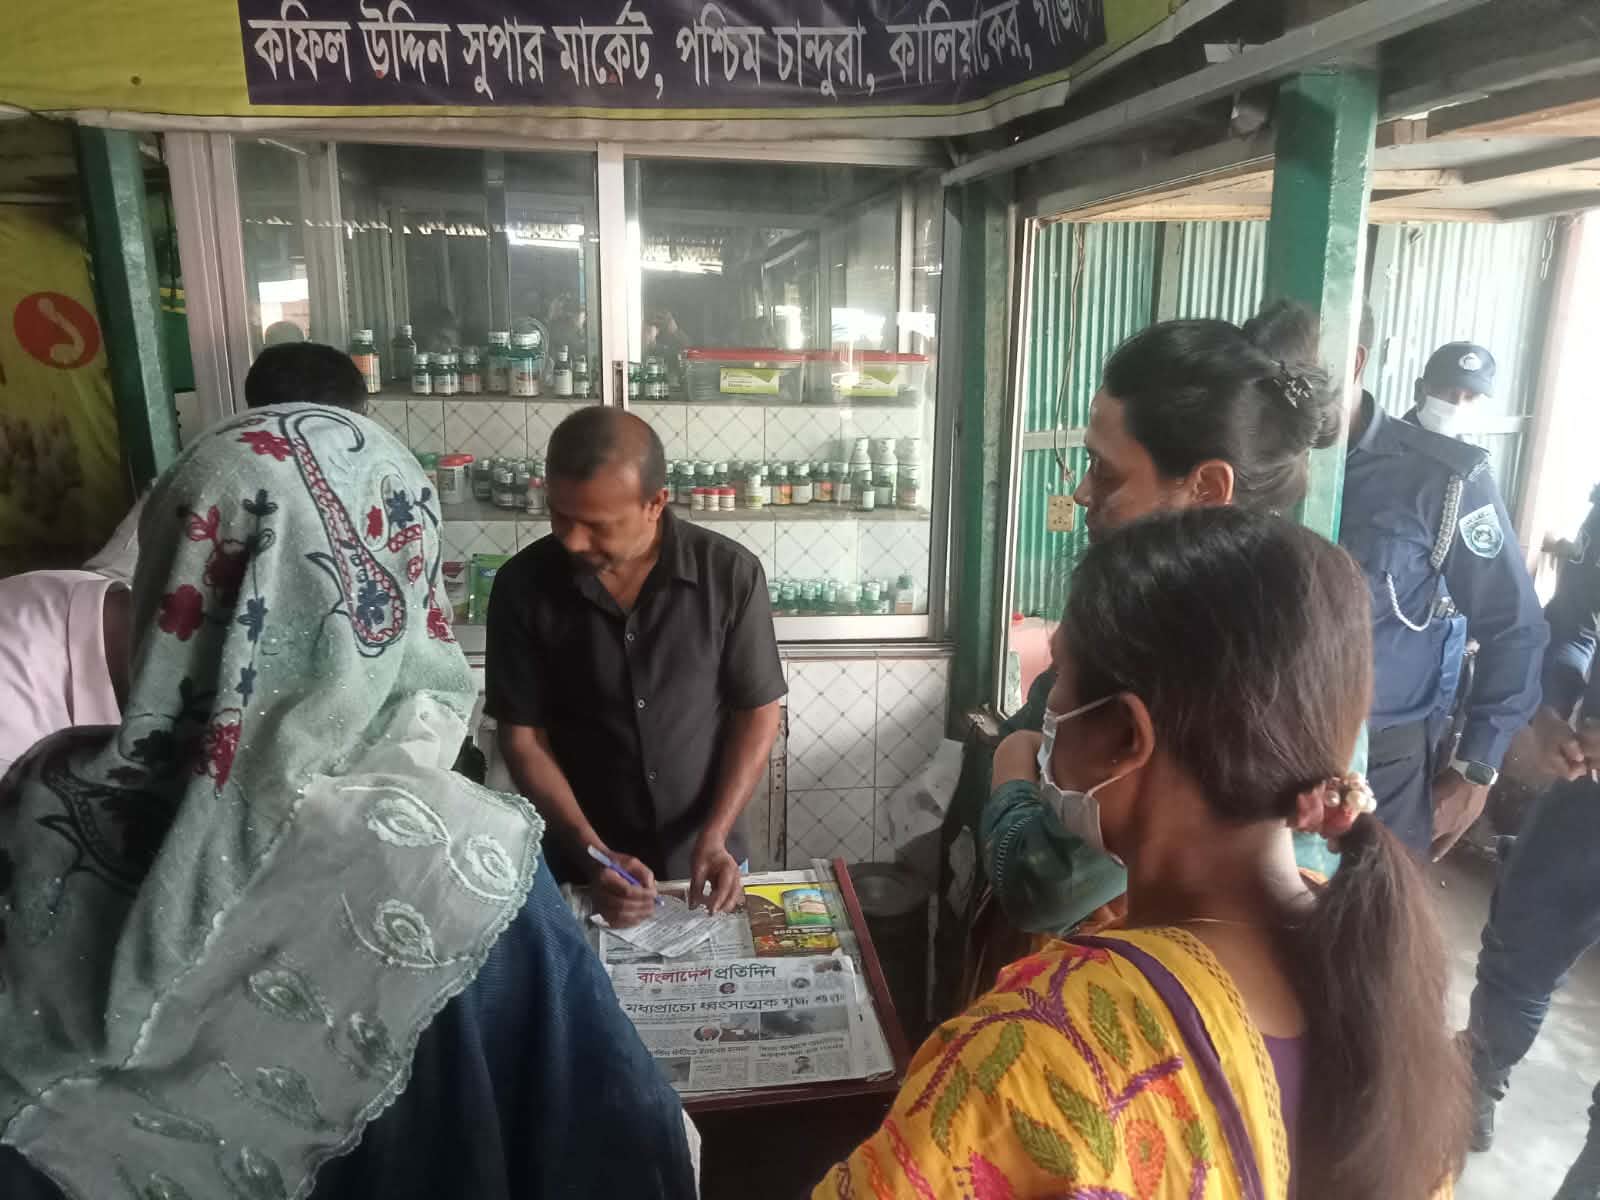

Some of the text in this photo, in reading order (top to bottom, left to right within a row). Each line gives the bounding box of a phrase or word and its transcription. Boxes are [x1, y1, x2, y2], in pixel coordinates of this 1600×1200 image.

[248, 1, 351, 83] কফিল
[358, 0, 450, 85] উদ্দিন
[457, 16, 546, 100] সুপার
[550, 0, 664, 100] মার্কেট,
[676, 2, 765, 87] পশ্চিম
[637, 963, 776, 985] বাংলাদেশ প্রতিদিন
